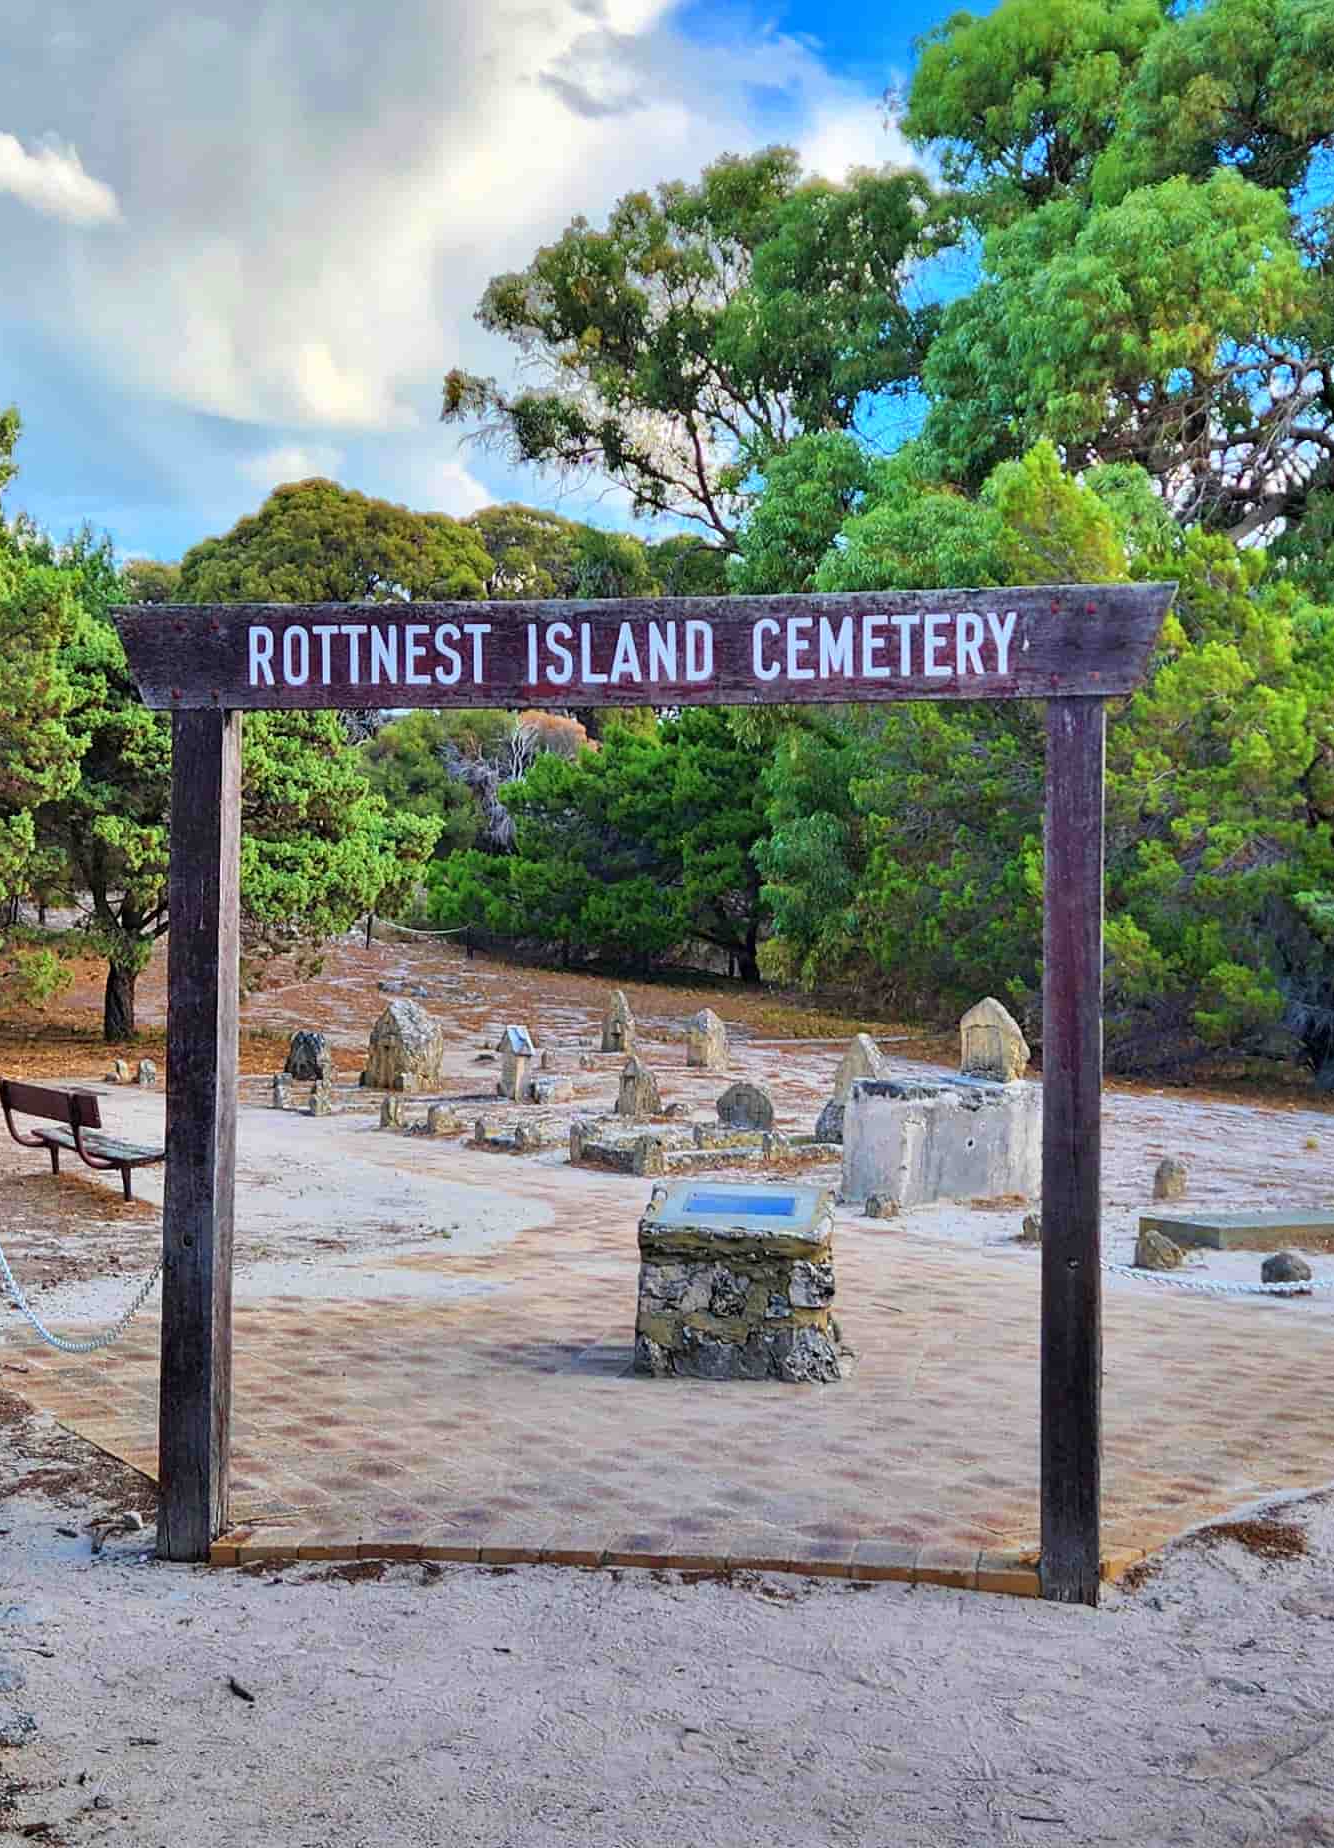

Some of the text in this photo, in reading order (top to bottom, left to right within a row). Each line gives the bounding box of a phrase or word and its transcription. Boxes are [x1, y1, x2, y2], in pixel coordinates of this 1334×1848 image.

[249, 612, 1017, 686] ROTTNEST ISLAND CEMETERY
